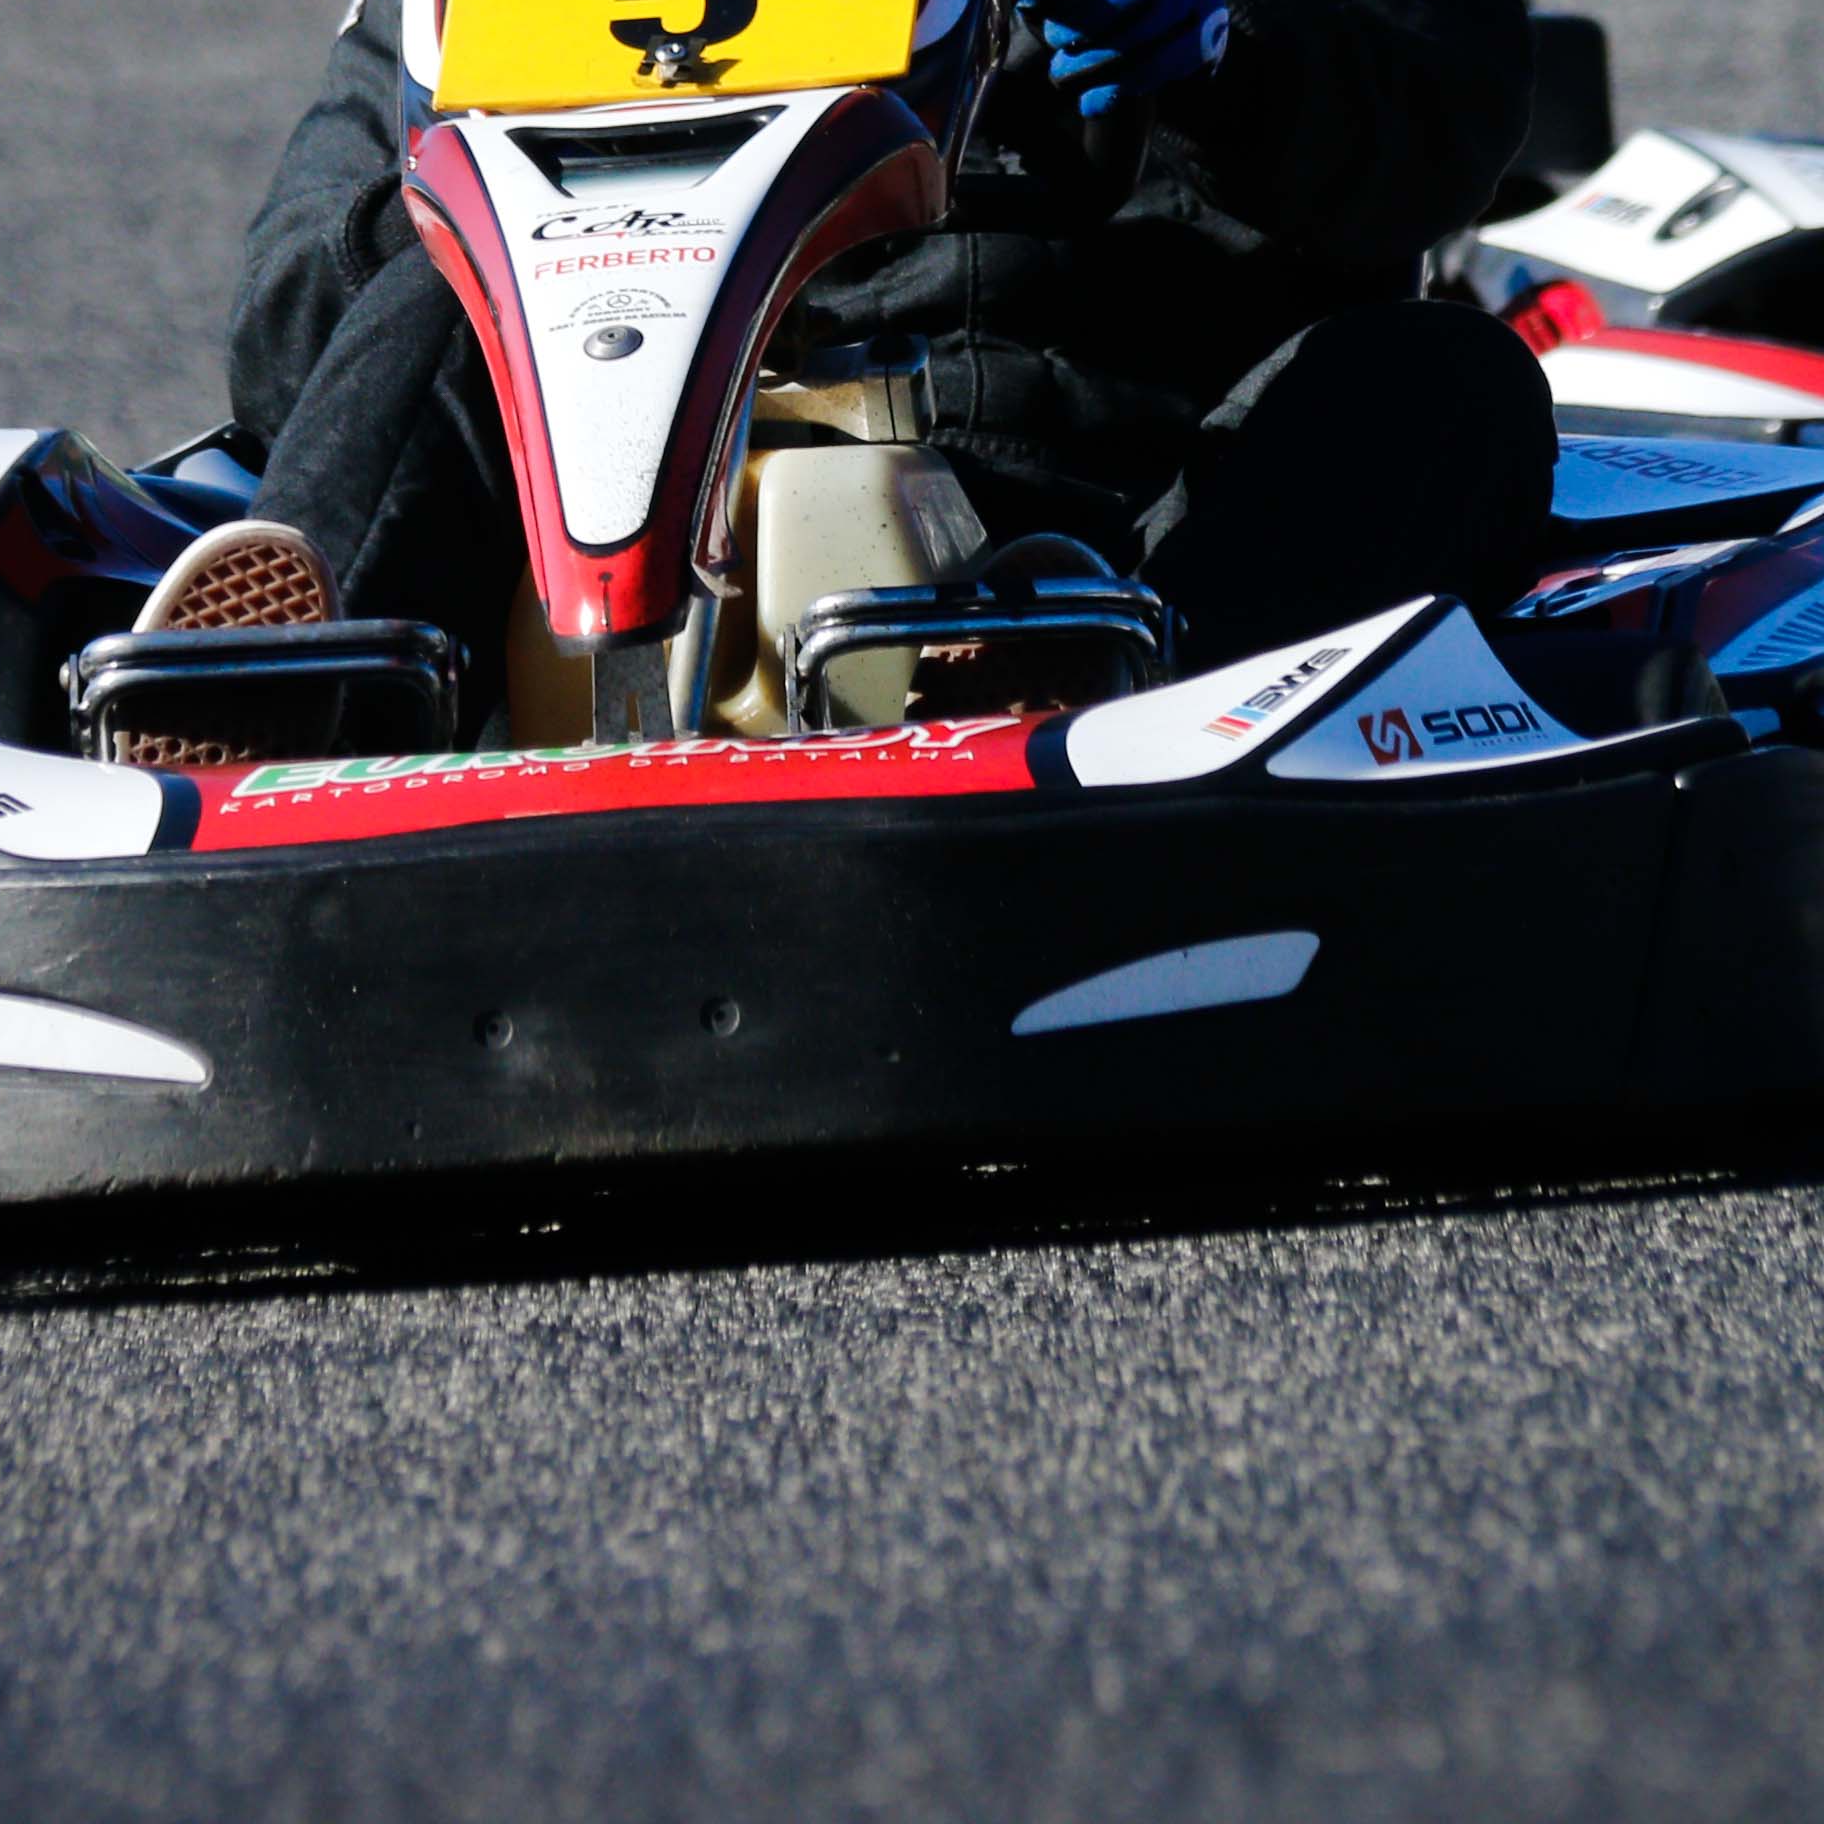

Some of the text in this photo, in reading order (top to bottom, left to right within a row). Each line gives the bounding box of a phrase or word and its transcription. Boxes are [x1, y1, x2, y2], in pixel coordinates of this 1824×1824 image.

[534, 246, 717, 280] FERBERTO
[1421, 701, 1543, 746] SODI
[729, 750, 975, 765] BATALHA
